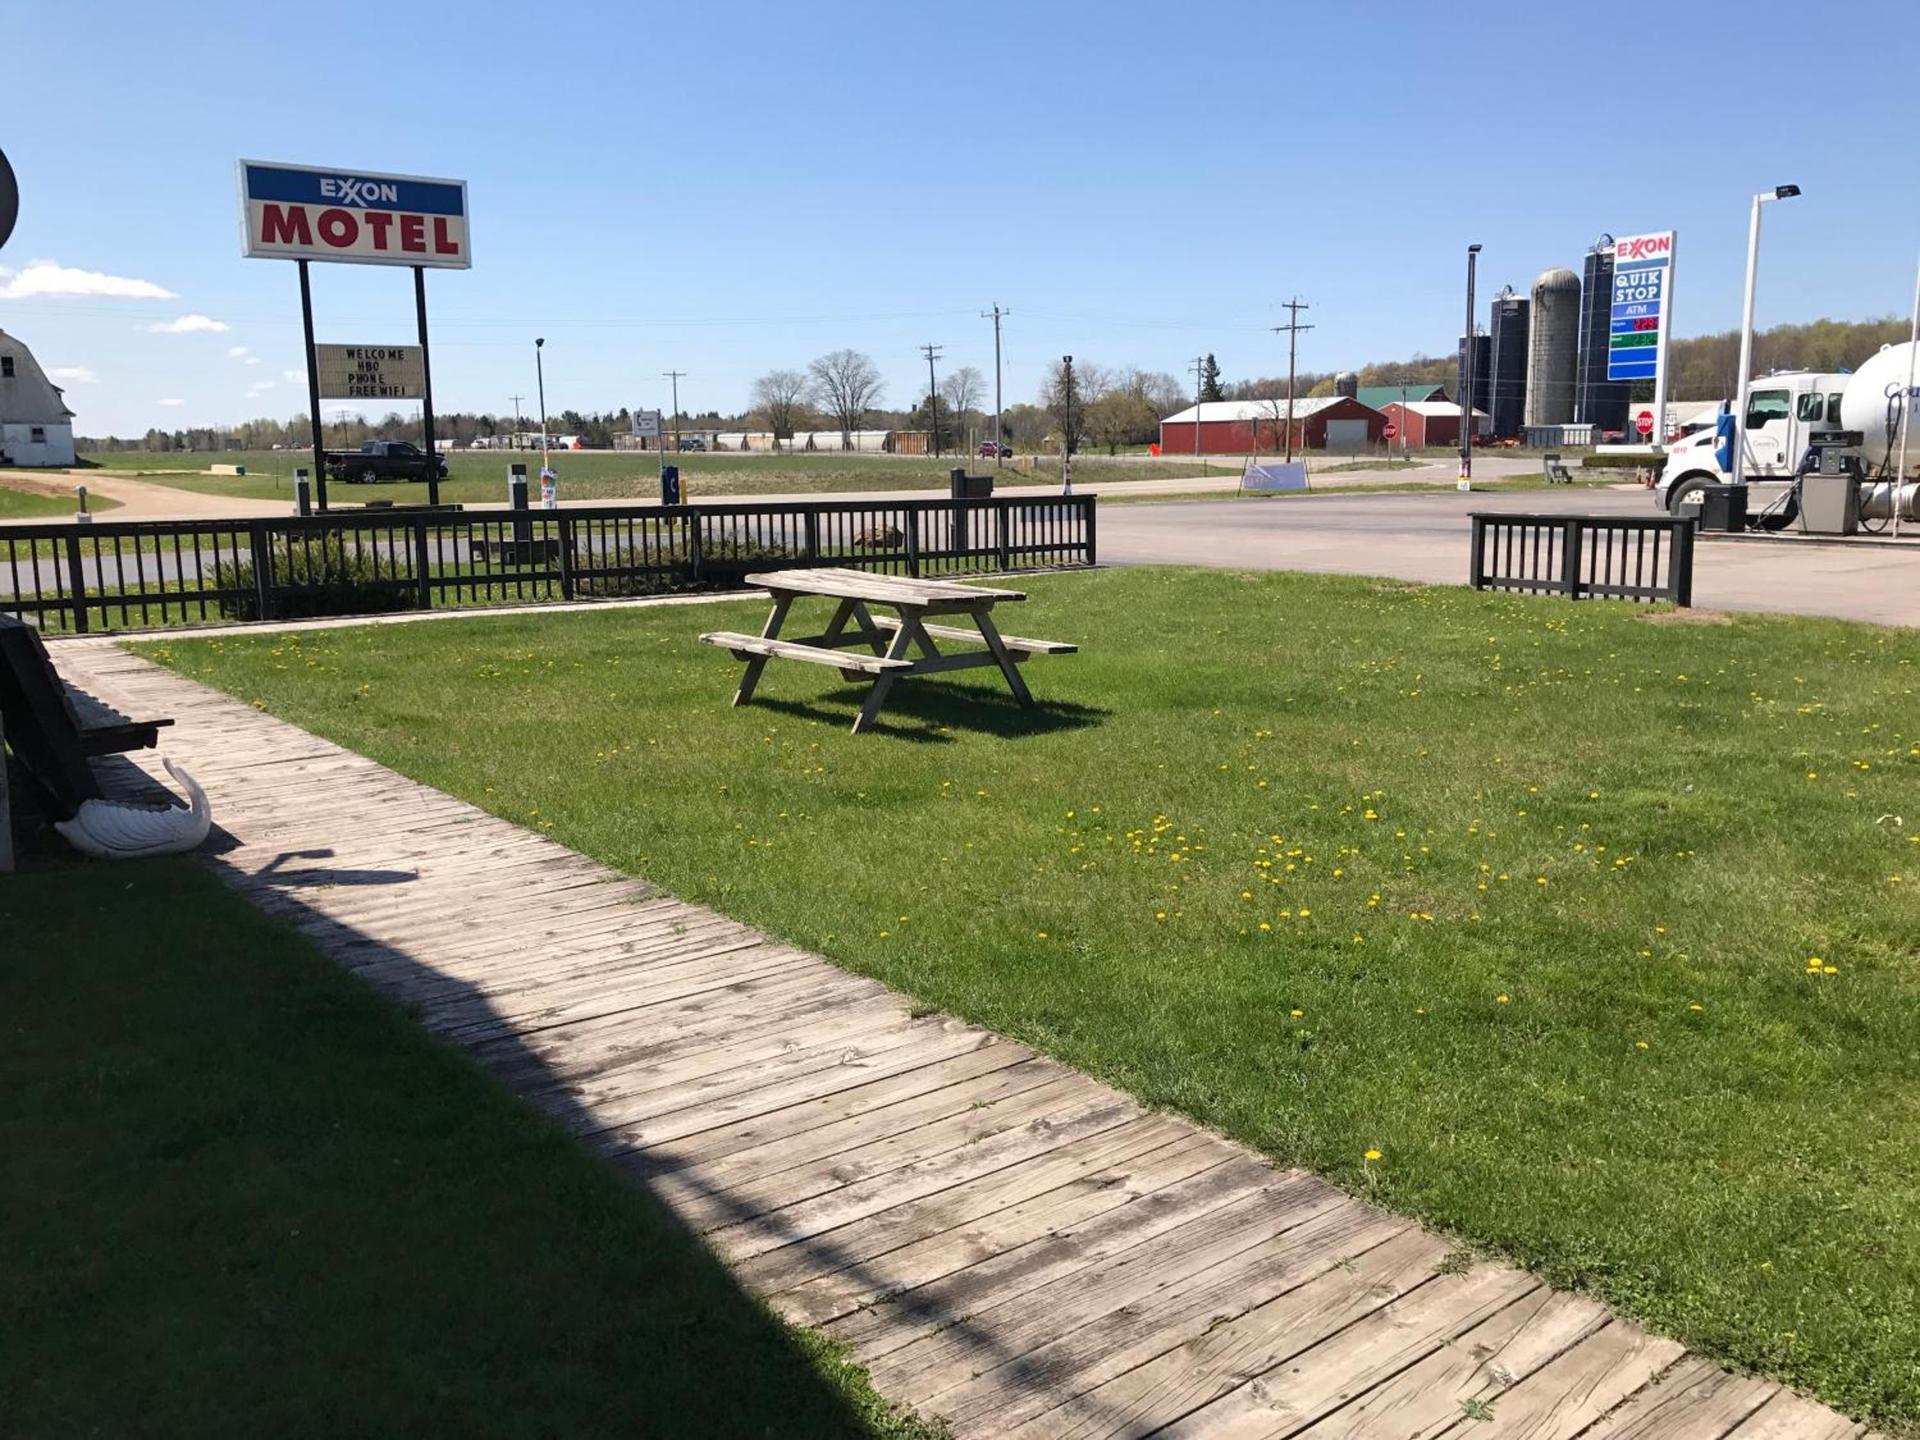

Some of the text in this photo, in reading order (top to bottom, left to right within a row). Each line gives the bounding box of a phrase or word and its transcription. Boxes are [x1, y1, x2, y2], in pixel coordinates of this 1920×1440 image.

[320, 178, 397, 207] EXXON
[261, 204, 459, 255] MOTEL
[1617, 236, 1670, 259] EXXON
[1616, 272, 1659, 287] QUIK
[1616, 287, 1657, 302] STOP
[1625, 304, 1647, 315] ATM
[346, 349, 404, 360] WELCOME
[357, 361, 379, 372] HBO
[348, 373, 385, 383] PHONE
[349, 385, 405, 397] FREE WIFI
[1636, 417, 1653, 427] STOP
